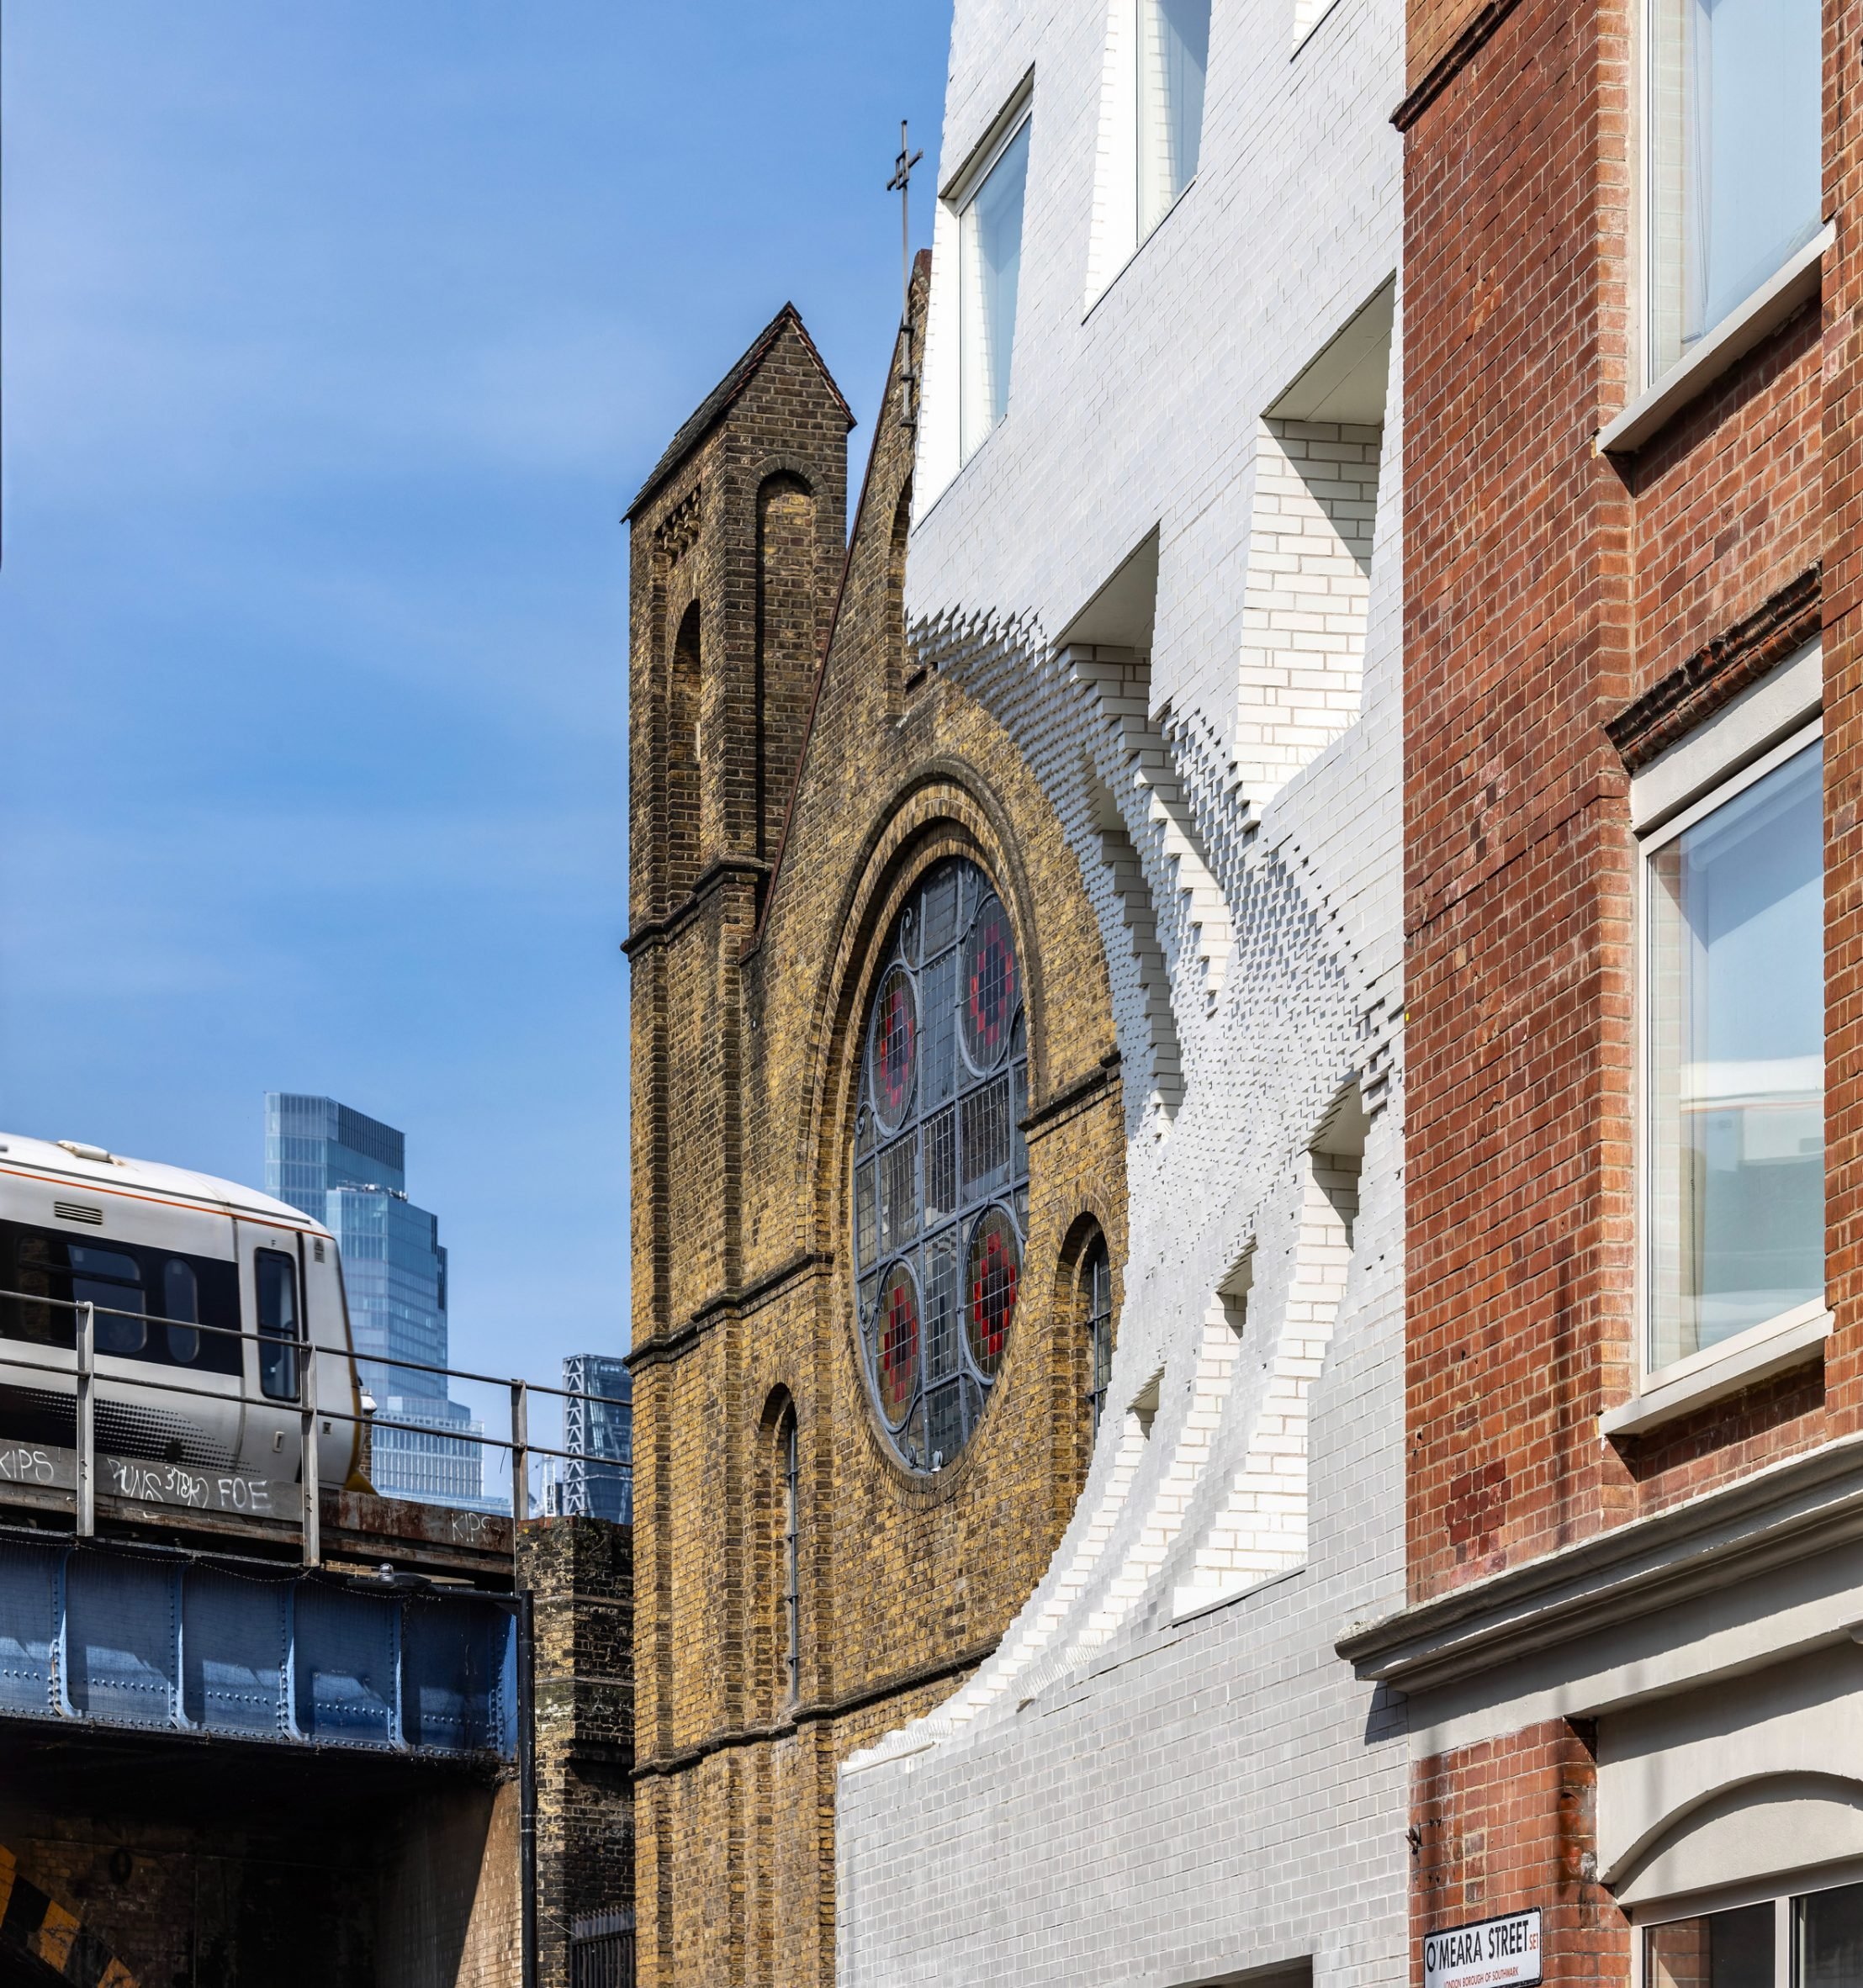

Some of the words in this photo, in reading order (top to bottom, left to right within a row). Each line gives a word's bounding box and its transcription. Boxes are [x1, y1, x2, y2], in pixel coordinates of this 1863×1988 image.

[0, 1449, 54, 1483] KIPS
[218, 1477, 271, 1509] FOE
[1426, 1932, 1483, 1972] O'MEARA
[1489, 1920, 1528, 1959] STREET
[1529, 1933, 1539, 1951] SE1
[1462, 1974, 1485, 1985] BOROUGH
[1485, 1971, 1491, 1982] OF
[1492, 1966, 1519, 1980] SOUTHWARK
